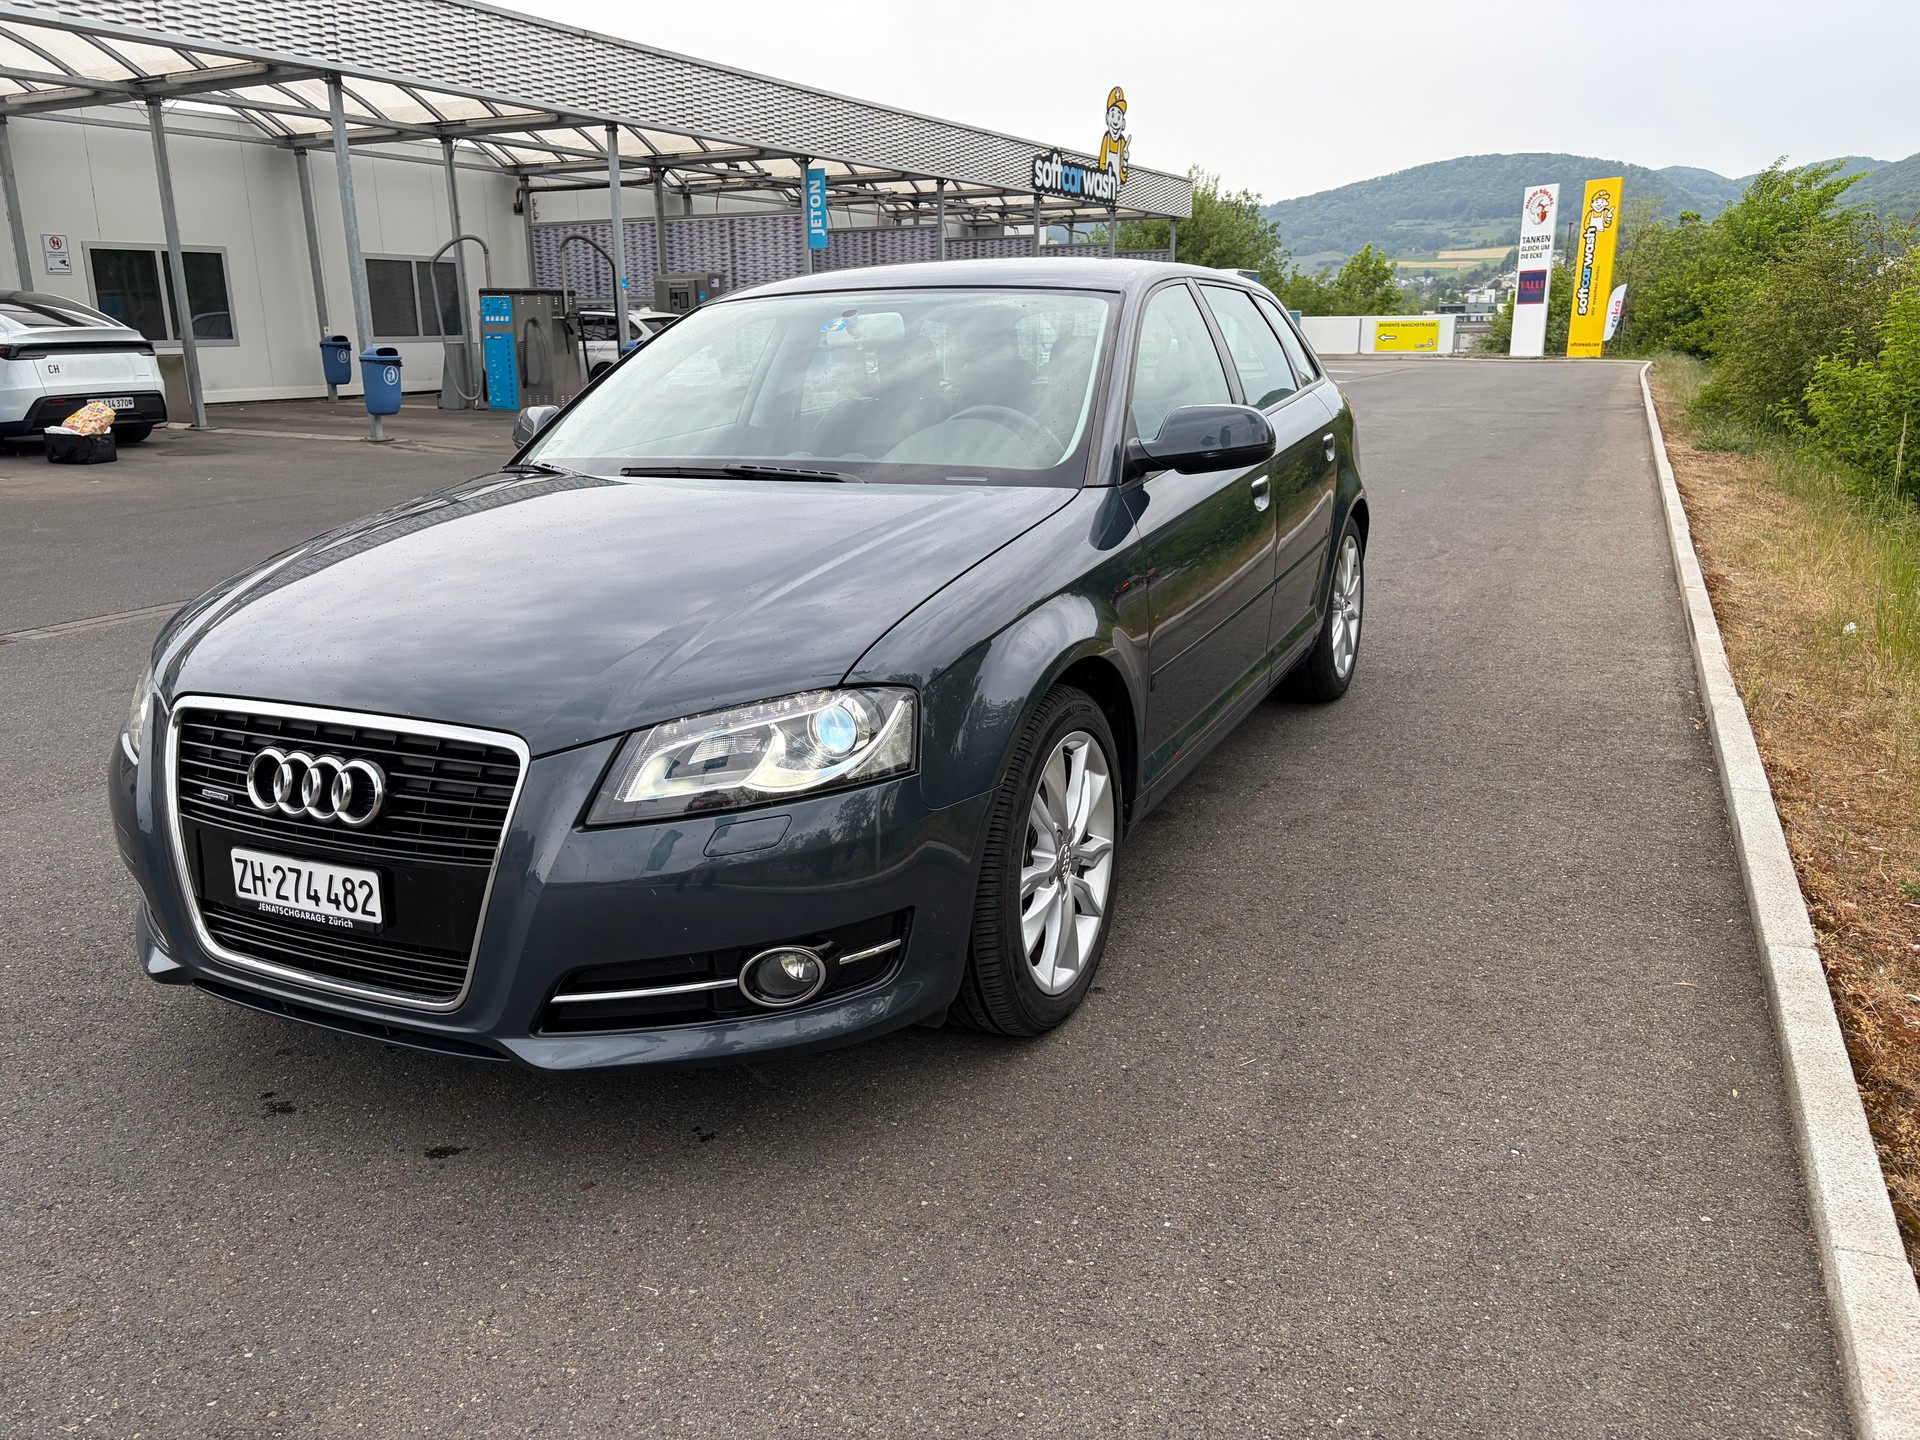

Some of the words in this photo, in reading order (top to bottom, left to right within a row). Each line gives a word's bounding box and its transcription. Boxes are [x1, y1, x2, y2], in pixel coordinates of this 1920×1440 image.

[809, 179, 825, 236] JETON
[1522, 234, 1551, 244] TANKEN
[48, 364, 60, 374] CH
[258, 902, 326, 923] JENATSCHGARAGE
[328, 916, 354, 929] Zürich
